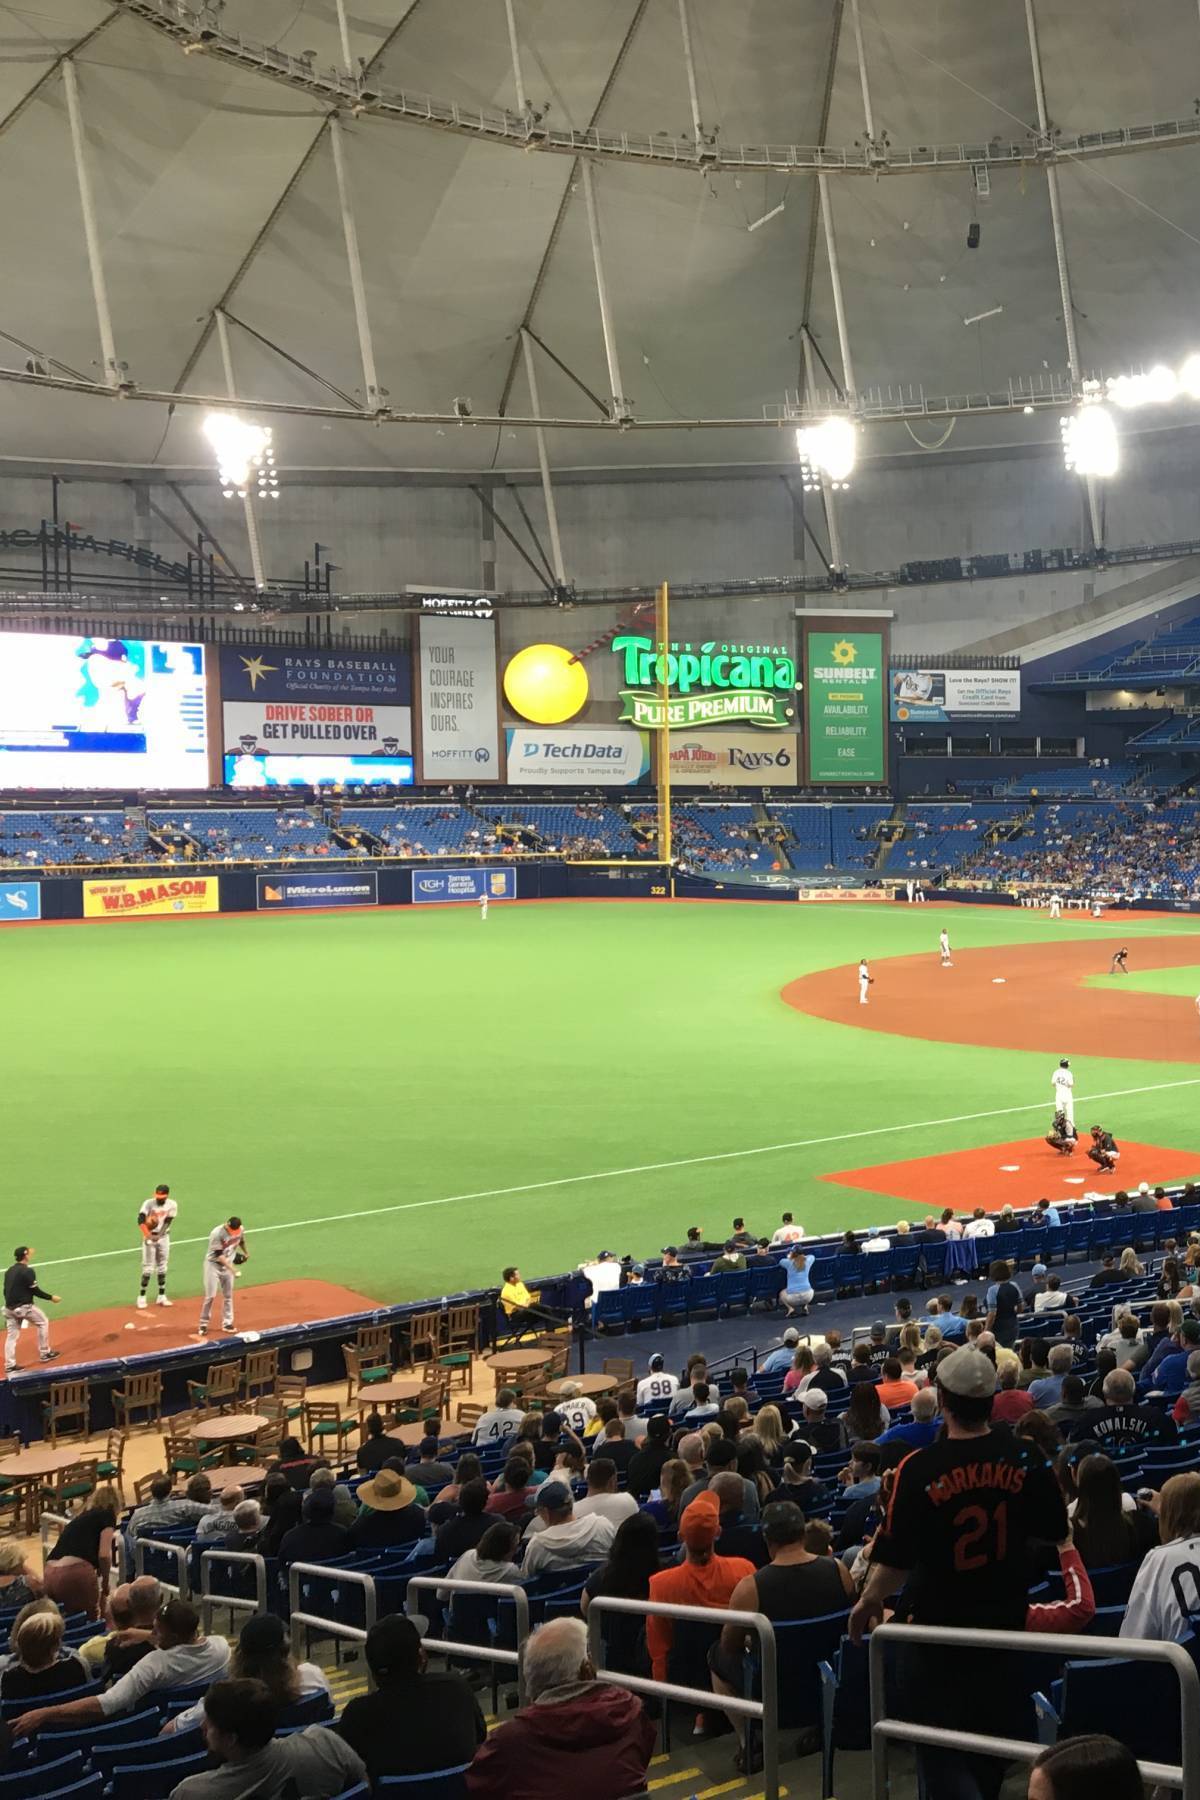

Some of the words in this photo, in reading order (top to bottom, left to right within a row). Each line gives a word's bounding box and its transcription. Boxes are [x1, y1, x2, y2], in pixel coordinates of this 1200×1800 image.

[429, 646, 455, 664] YOUR
[721, 644, 788, 655] ORIGINAL
[285, 658, 320, 668] RAYS
[327, 659, 397, 671] BASEBALL
[612, 636, 796, 693] Tropicana
[286, 670, 396, 684] FOUNDATION
[429, 669, 475, 687] COURAGE
[814, 667, 876, 679] SUNBELT
[430, 692, 473, 710] INSPIRES
[266, 705, 306, 722] DRIVE
[309, 706, 353, 723] SOBER
[356, 708, 374, 723] OR
[634, 700, 685, 723] PURE
[688, 697, 774, 720] PREMIUM
[824, 705, 869, 715] AVAILABILITY
[431, 714, 460, 731] OURS.
[262, 723, 289, 739] GET
[291, 724, 341, 740] PULLED
[343, 725, 378, 741] OVER
[825, 726, 867, 736] RELIABILITY
[432, 750, 473, 759] MOFFITT
[775, 748, 791, 767] 6
[838, 748, 856, 758] EASE
[520, 767, 548, 775] Proudly
[550, 767, 585, 775] Supports
[587, 767, 611, 775] Tampa
[612, 767, 626, 776] Bay
[423, 880, 445, 888] TGH
[448, 886, 476, 894] Hospital
[650, 887, 665, 895] 322
[650, 1380, 672, 1396] 98
[489, 1421, 514, 1437] 42
[1092, 1416, 1148, 1436] KOWALSKI
[927, 1461, 1026, 1506] MARKAKIS
[953, 1500, 1008, 1571] 21
